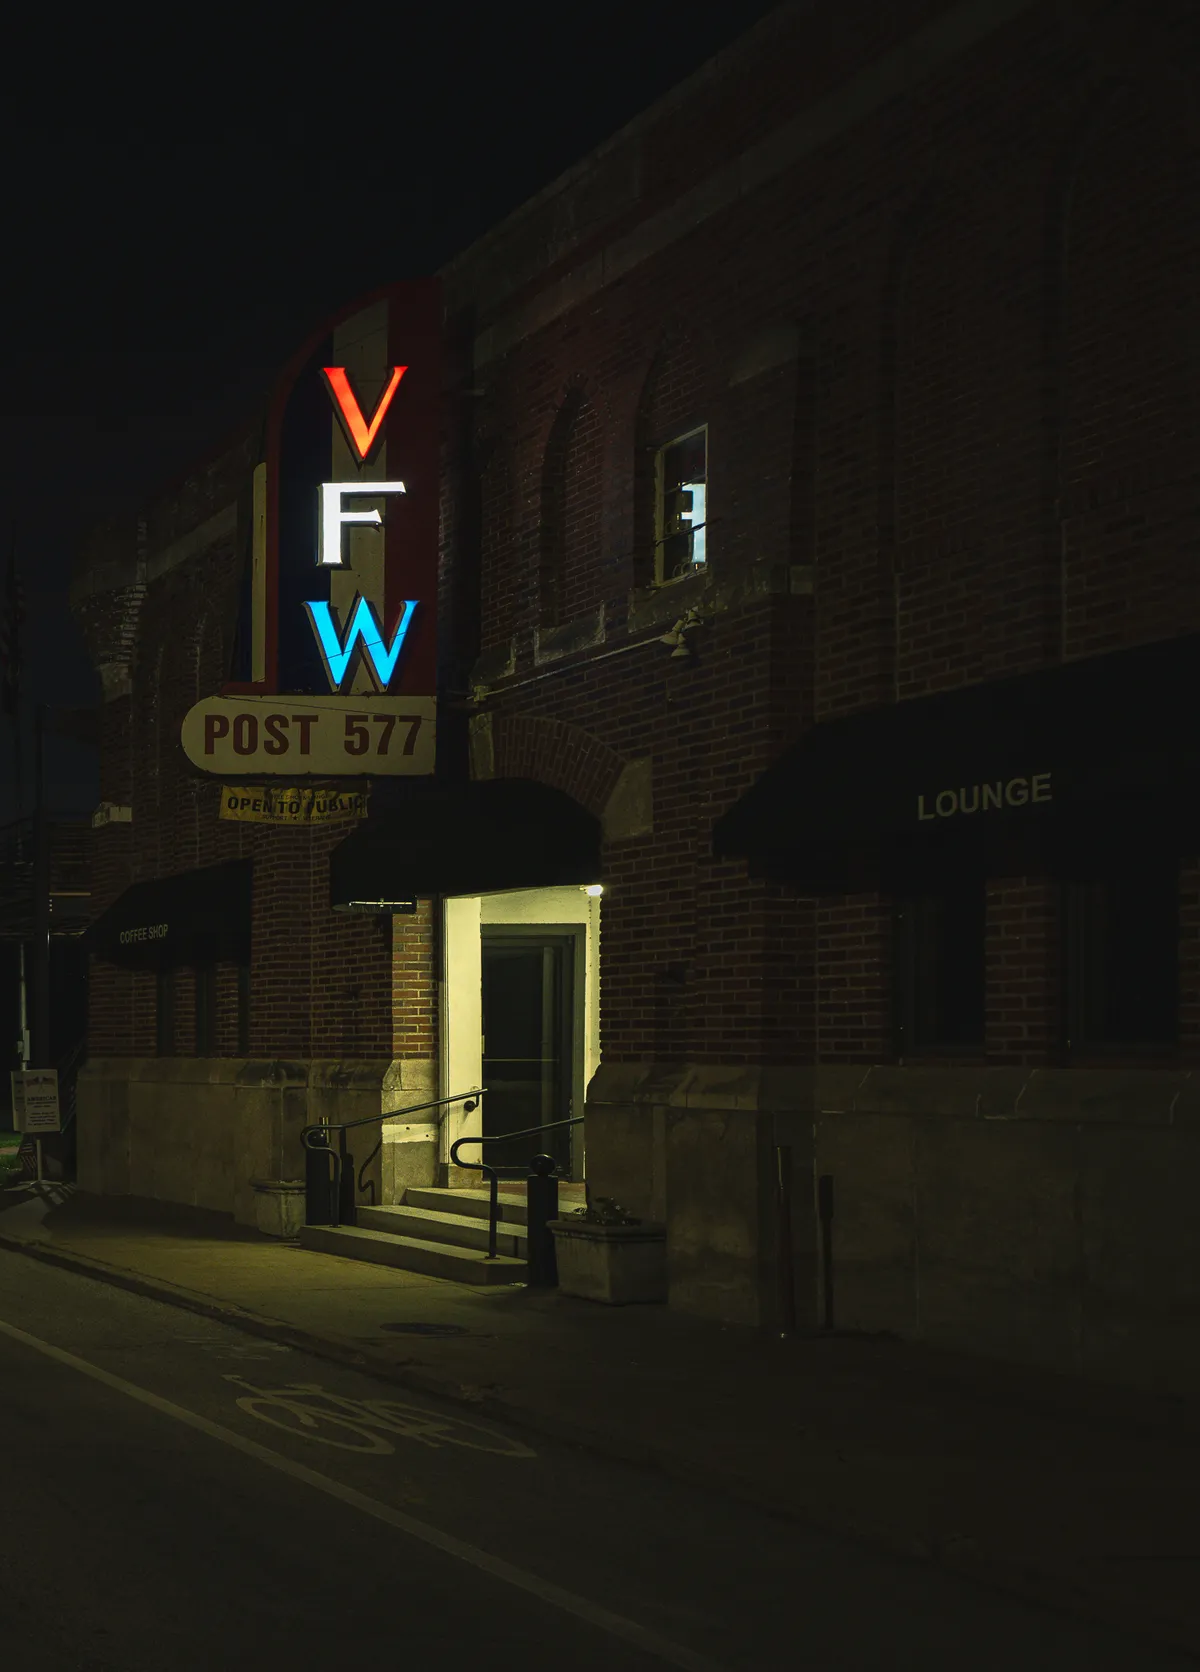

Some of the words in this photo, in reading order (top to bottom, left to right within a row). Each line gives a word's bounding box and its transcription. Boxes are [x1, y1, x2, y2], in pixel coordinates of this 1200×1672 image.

[204, 714, 319, 756] POST
[344, 714, 422, 756] 577
[227, 796, 272, 813] OPEN
[277, 800, 300, 814] TO
[917, 772, 1053, 821] LOUNGE
[120, 927, 148, 945] COFFEE
[148, 923, 169, 940] SHOP
